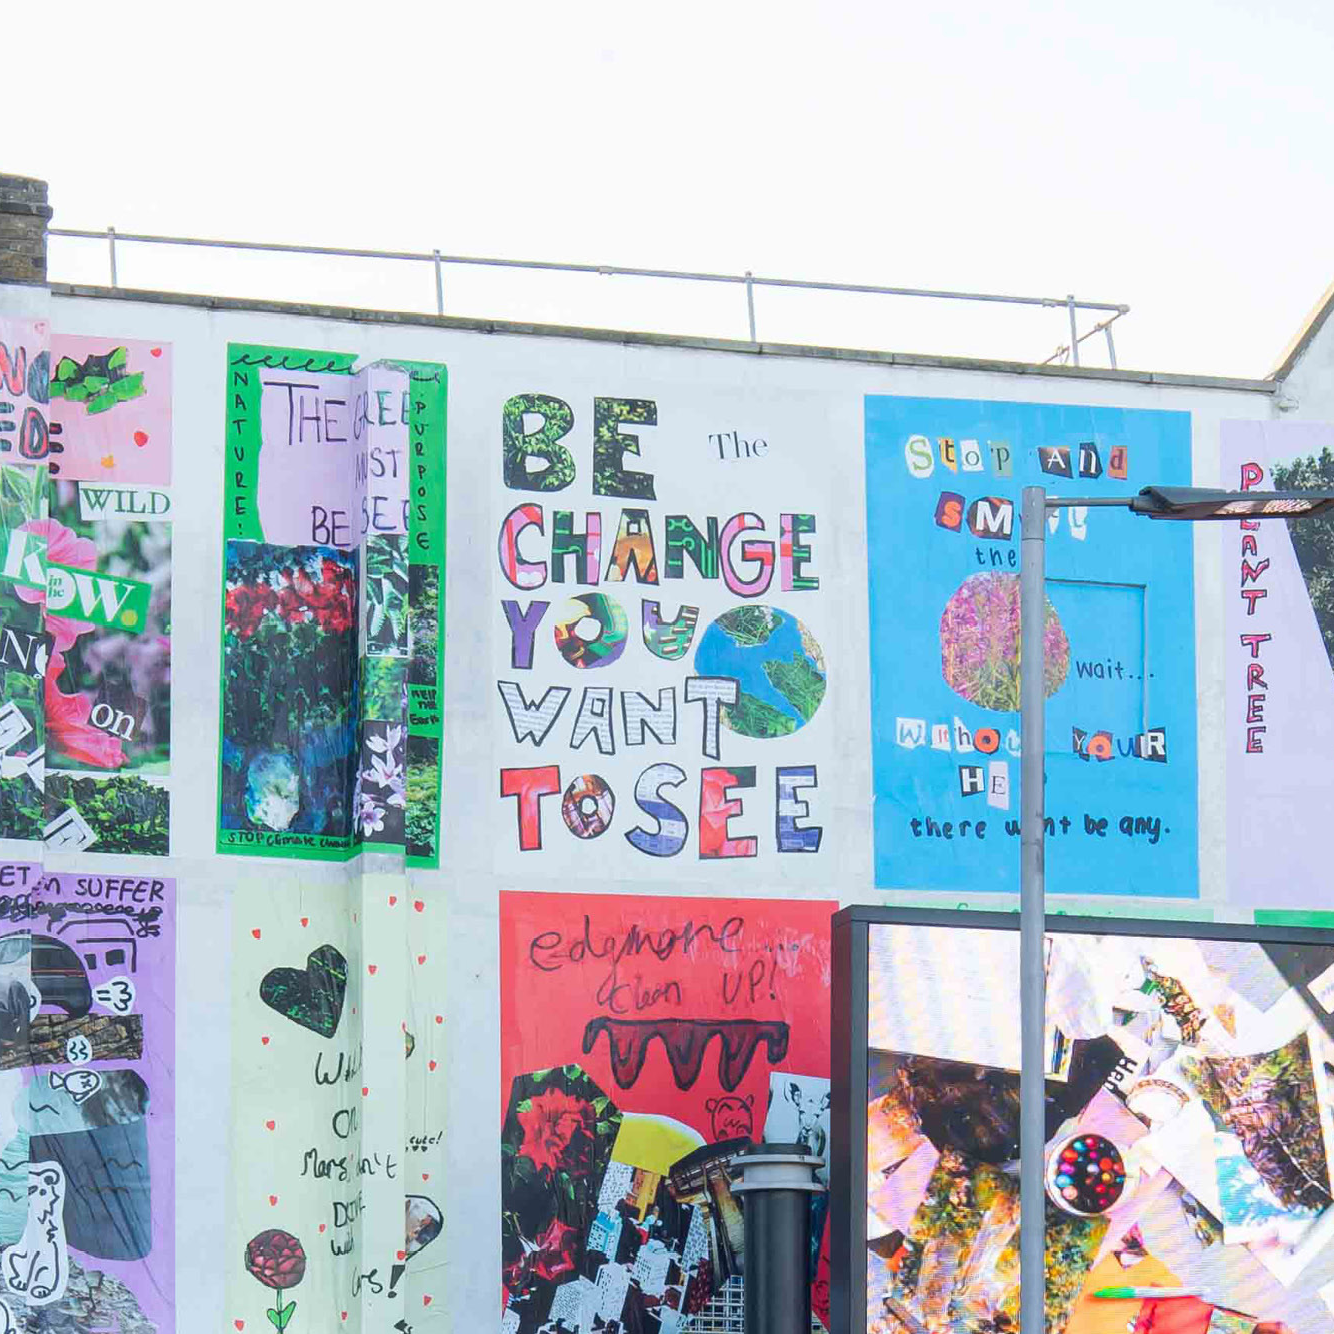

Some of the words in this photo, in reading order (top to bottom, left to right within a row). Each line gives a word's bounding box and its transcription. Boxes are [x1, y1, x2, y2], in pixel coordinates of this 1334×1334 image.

[264, 382, 347, 446] THE
[503, 393, 658, 500] BE
[709, 431, 768, 460] The
[80, 488, 171, 515] WILD
[312, 505, 351, 546] BE
[499, 503, 819, 618] CHANGE
[975, 547, 1017, 568] the
[501, 593, 699, 690] YOU
[1240, 632, 1272, 753] TREE
[90, 703, 136, 741] on
[498, 676, 760, 781] WANT
[910, 817, 988, 840] there
[1083, 813, 1109, 837] be
[75, 878, 165, 902] SUFFER
